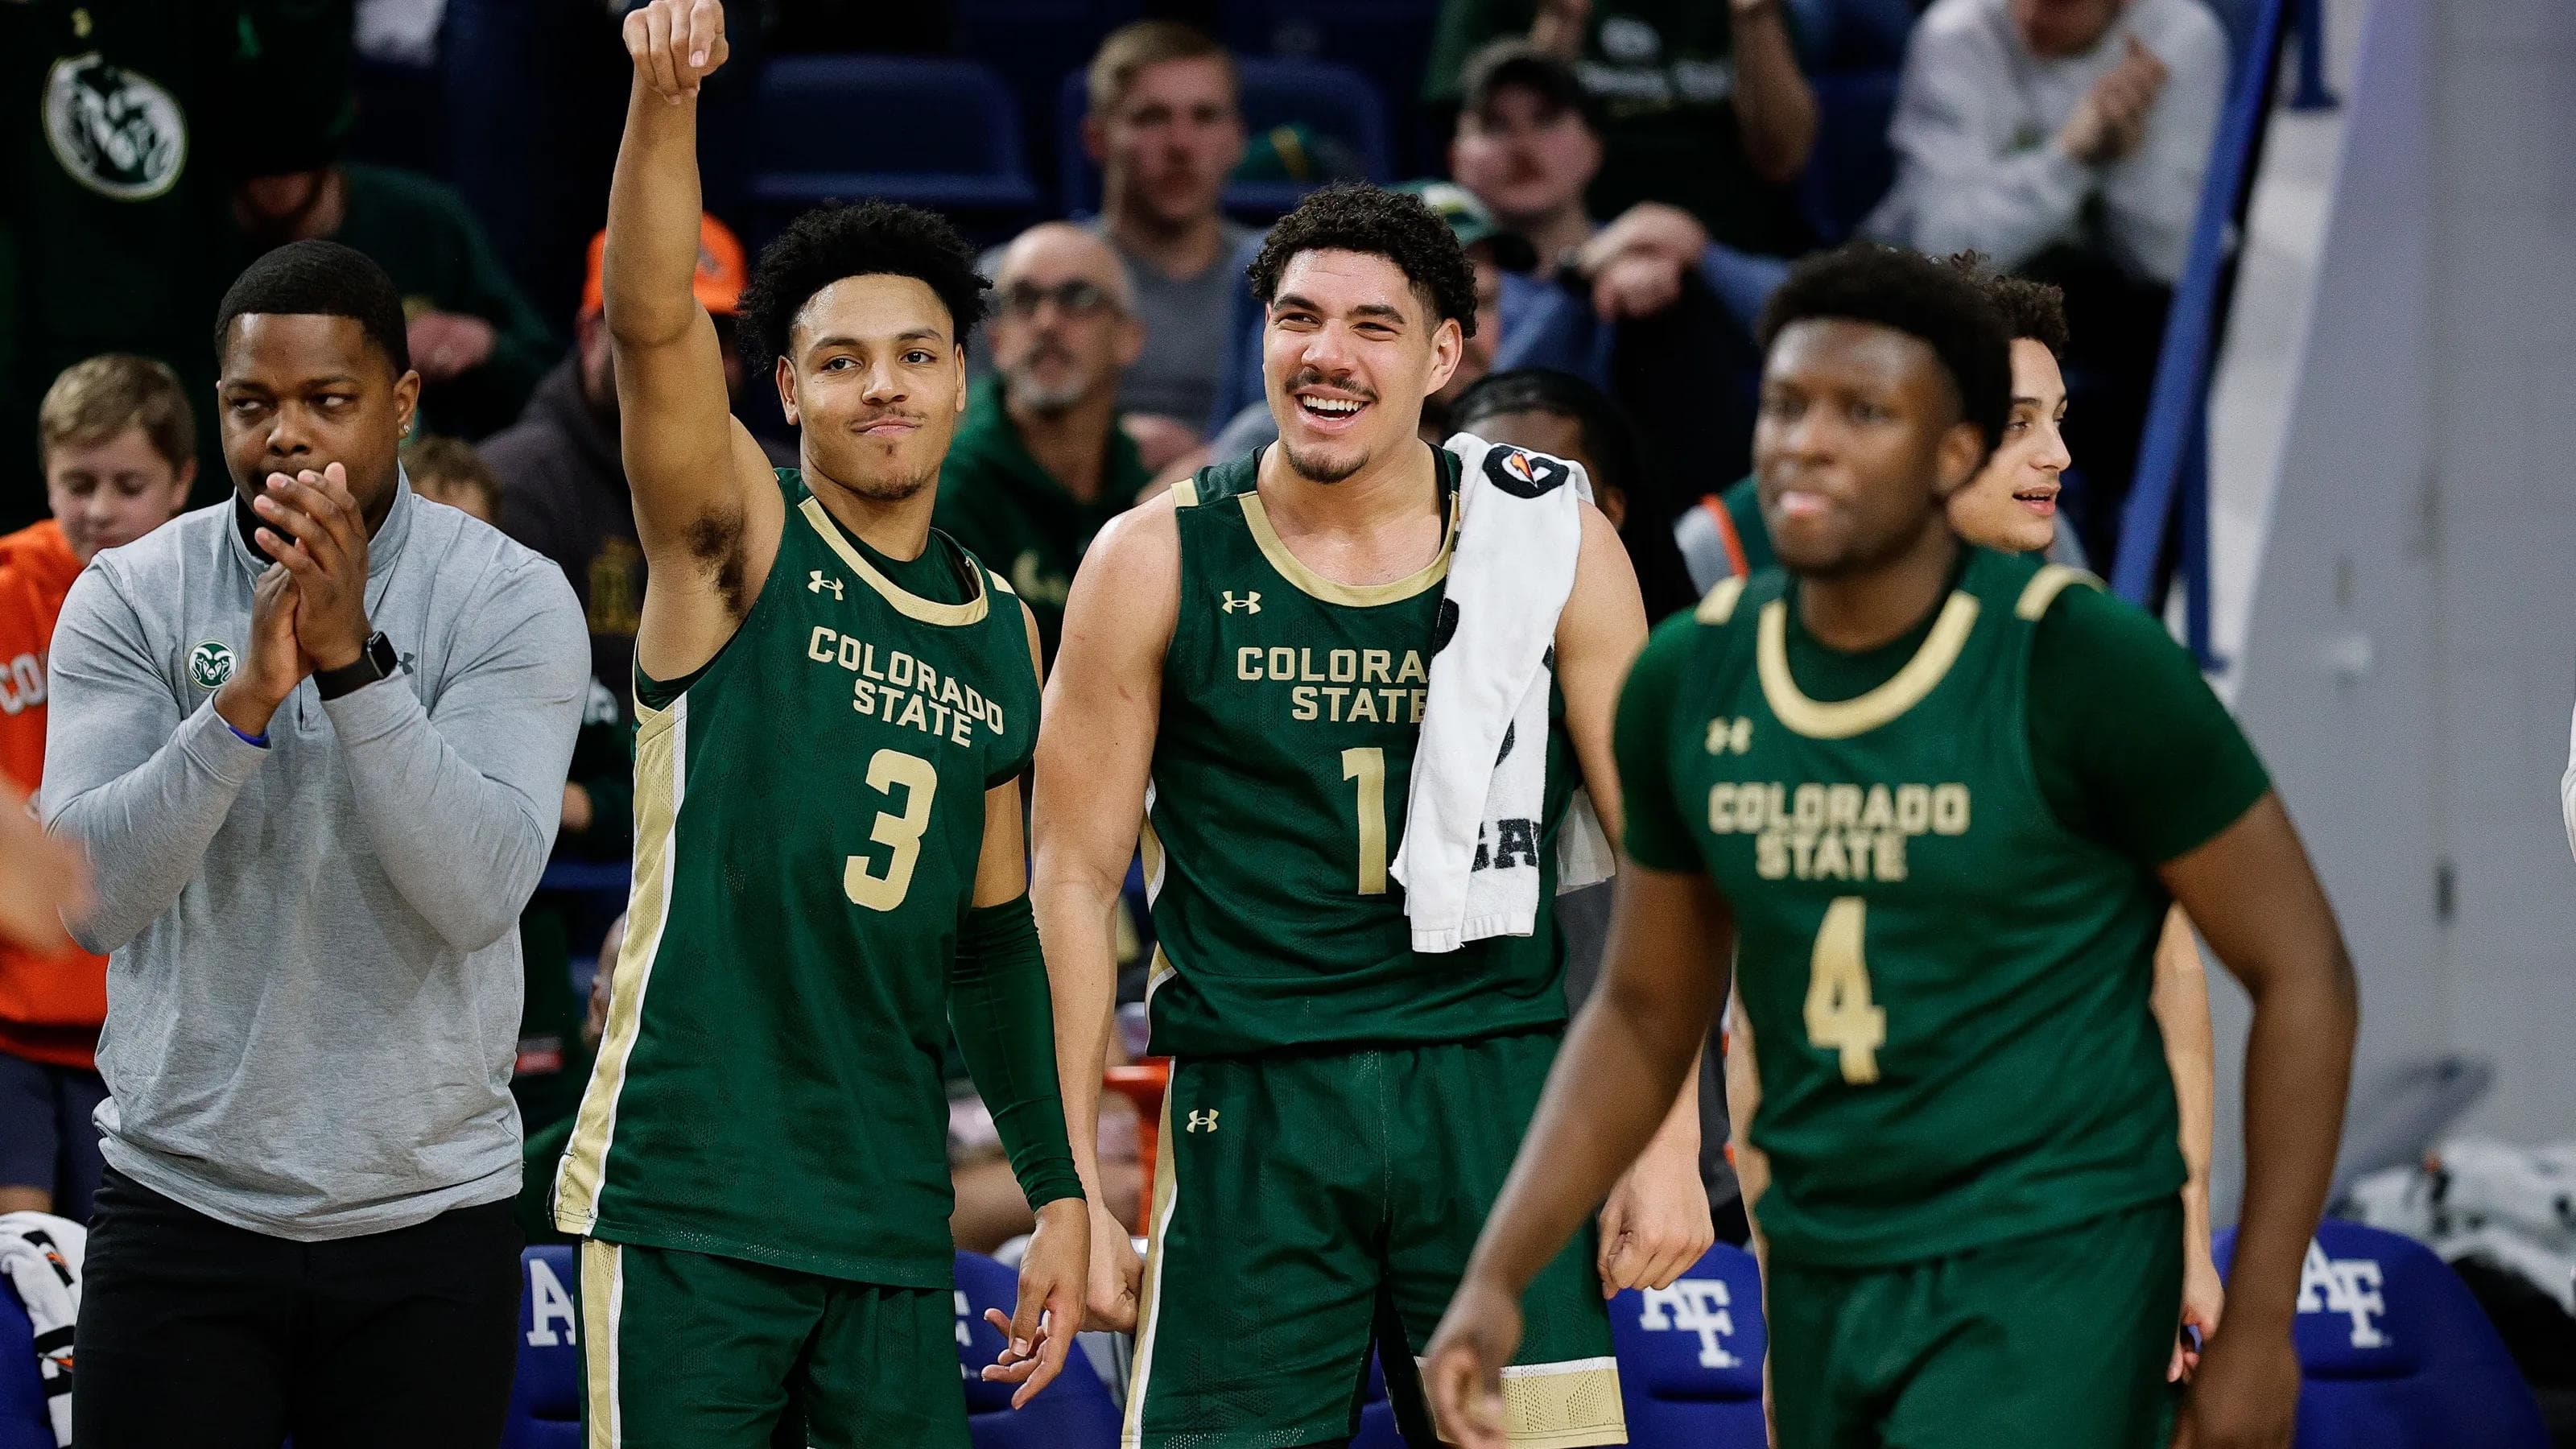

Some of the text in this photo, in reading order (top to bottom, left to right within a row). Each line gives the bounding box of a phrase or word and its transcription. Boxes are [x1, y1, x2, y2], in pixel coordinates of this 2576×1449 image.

[0, 653, 47, 715] CO
[808, 625, 1004, 735] COLORADO
[1237, 646, 1429, 683] COLORA
[853, 678, 972, 748] STATE
[1292, 686, 1428, 724] STATE
[843, 748, 938, 912] 3
[1342, 747, 1386, 895] 1
[1707, 781, 1971, 836] COLORADO
[1755, 829, 1909, 882] STATE
[1803, 895, 1887, 1086] 4
[526, 1257, 576, 1346] A
